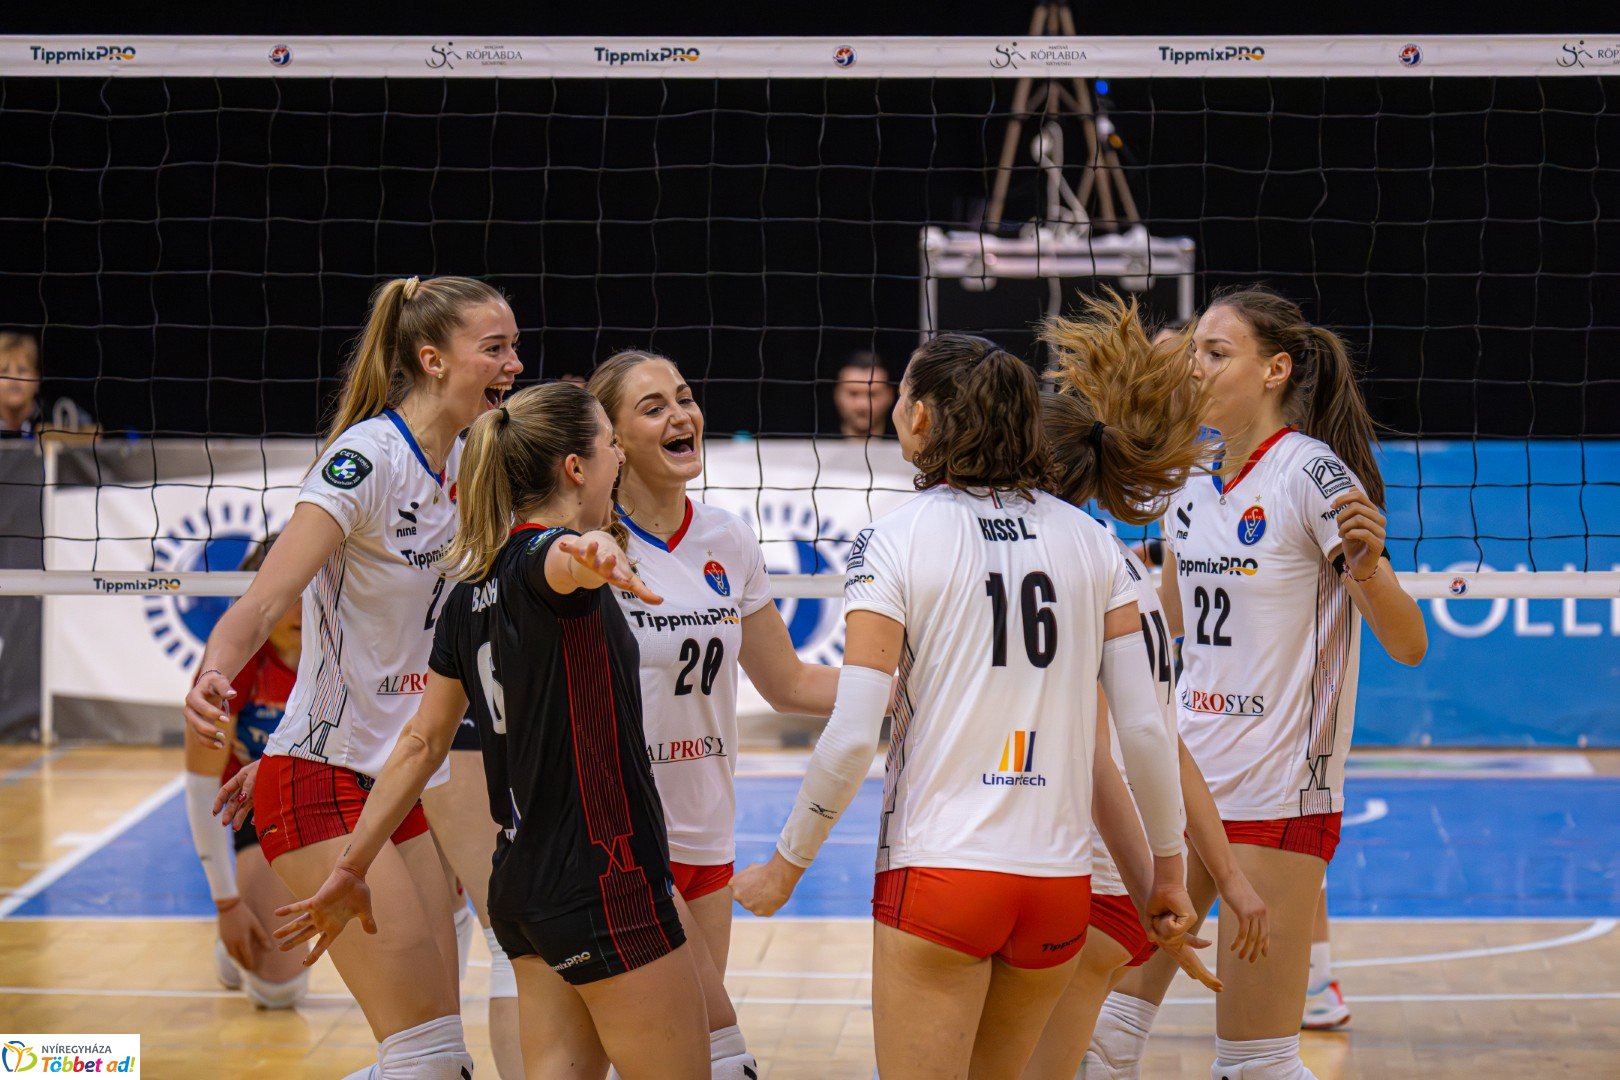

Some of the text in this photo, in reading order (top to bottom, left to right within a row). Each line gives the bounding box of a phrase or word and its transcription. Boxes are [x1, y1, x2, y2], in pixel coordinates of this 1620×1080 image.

[30, 46, 136, 64] TippmixPRO
[466, 48, 522, 60] RÖPLABDA
[594, 46, 700, 65] TippmixPRO
[1030, 49, 1087, 60] RÖPLABDA
[1158, 46, 1265, 64] TippmixPRO
[396, 526, 417, 538] nine
[978, 517, 1019, 541] KISS
[93, 578, 181, 592] TippmixPRO
[630, 608, 741, 632] TippmixPRO
[985, 571, 1058, 668] 16
[1194, 586, 1232, 646] 22
[674, 637, 725, 696] 20
[377, 673, 428, 694] ALPR
[983, 773, 1046, 786] Linartech
